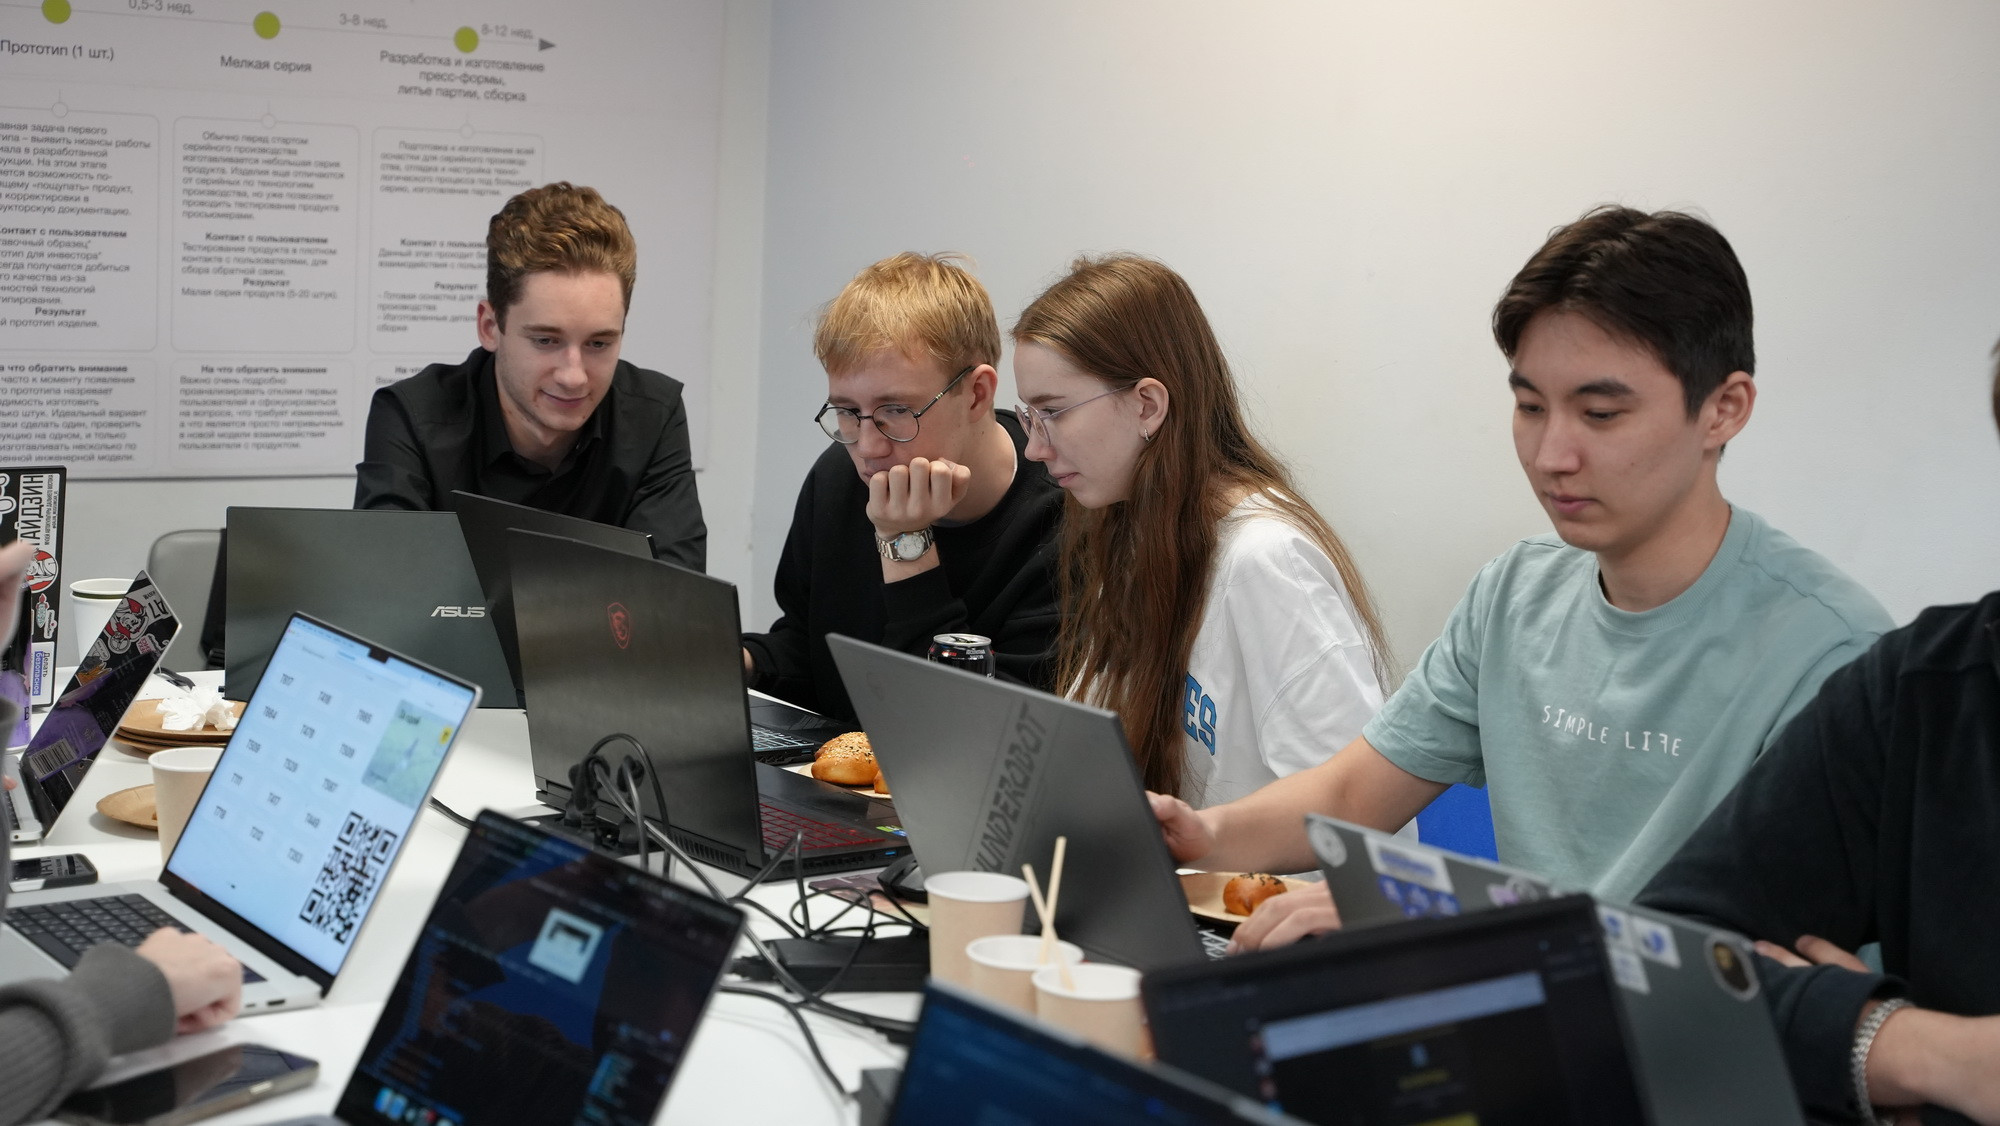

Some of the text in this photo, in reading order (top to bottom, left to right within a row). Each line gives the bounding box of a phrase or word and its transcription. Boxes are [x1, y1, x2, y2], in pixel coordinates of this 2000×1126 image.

[167, 2, 194, 14] нед.
[364, 17, 388, 30] нед.
[0, 40, 114, 61] Прототип (1 шт.)
[220, 56, 312, 73] Мелкая серия
[380, 50, 544, 72] Разработка и изготовление
[398, 84, 432, 96] литье
[484, 88, 526, 102] сборка
[35, 306, 86, 317] Результат
[431, 606, 485, 618] ASUS
[34, 652, 43, 695] безопасное
[1542, 705, 1682, 756] SIMPLE LIFE
